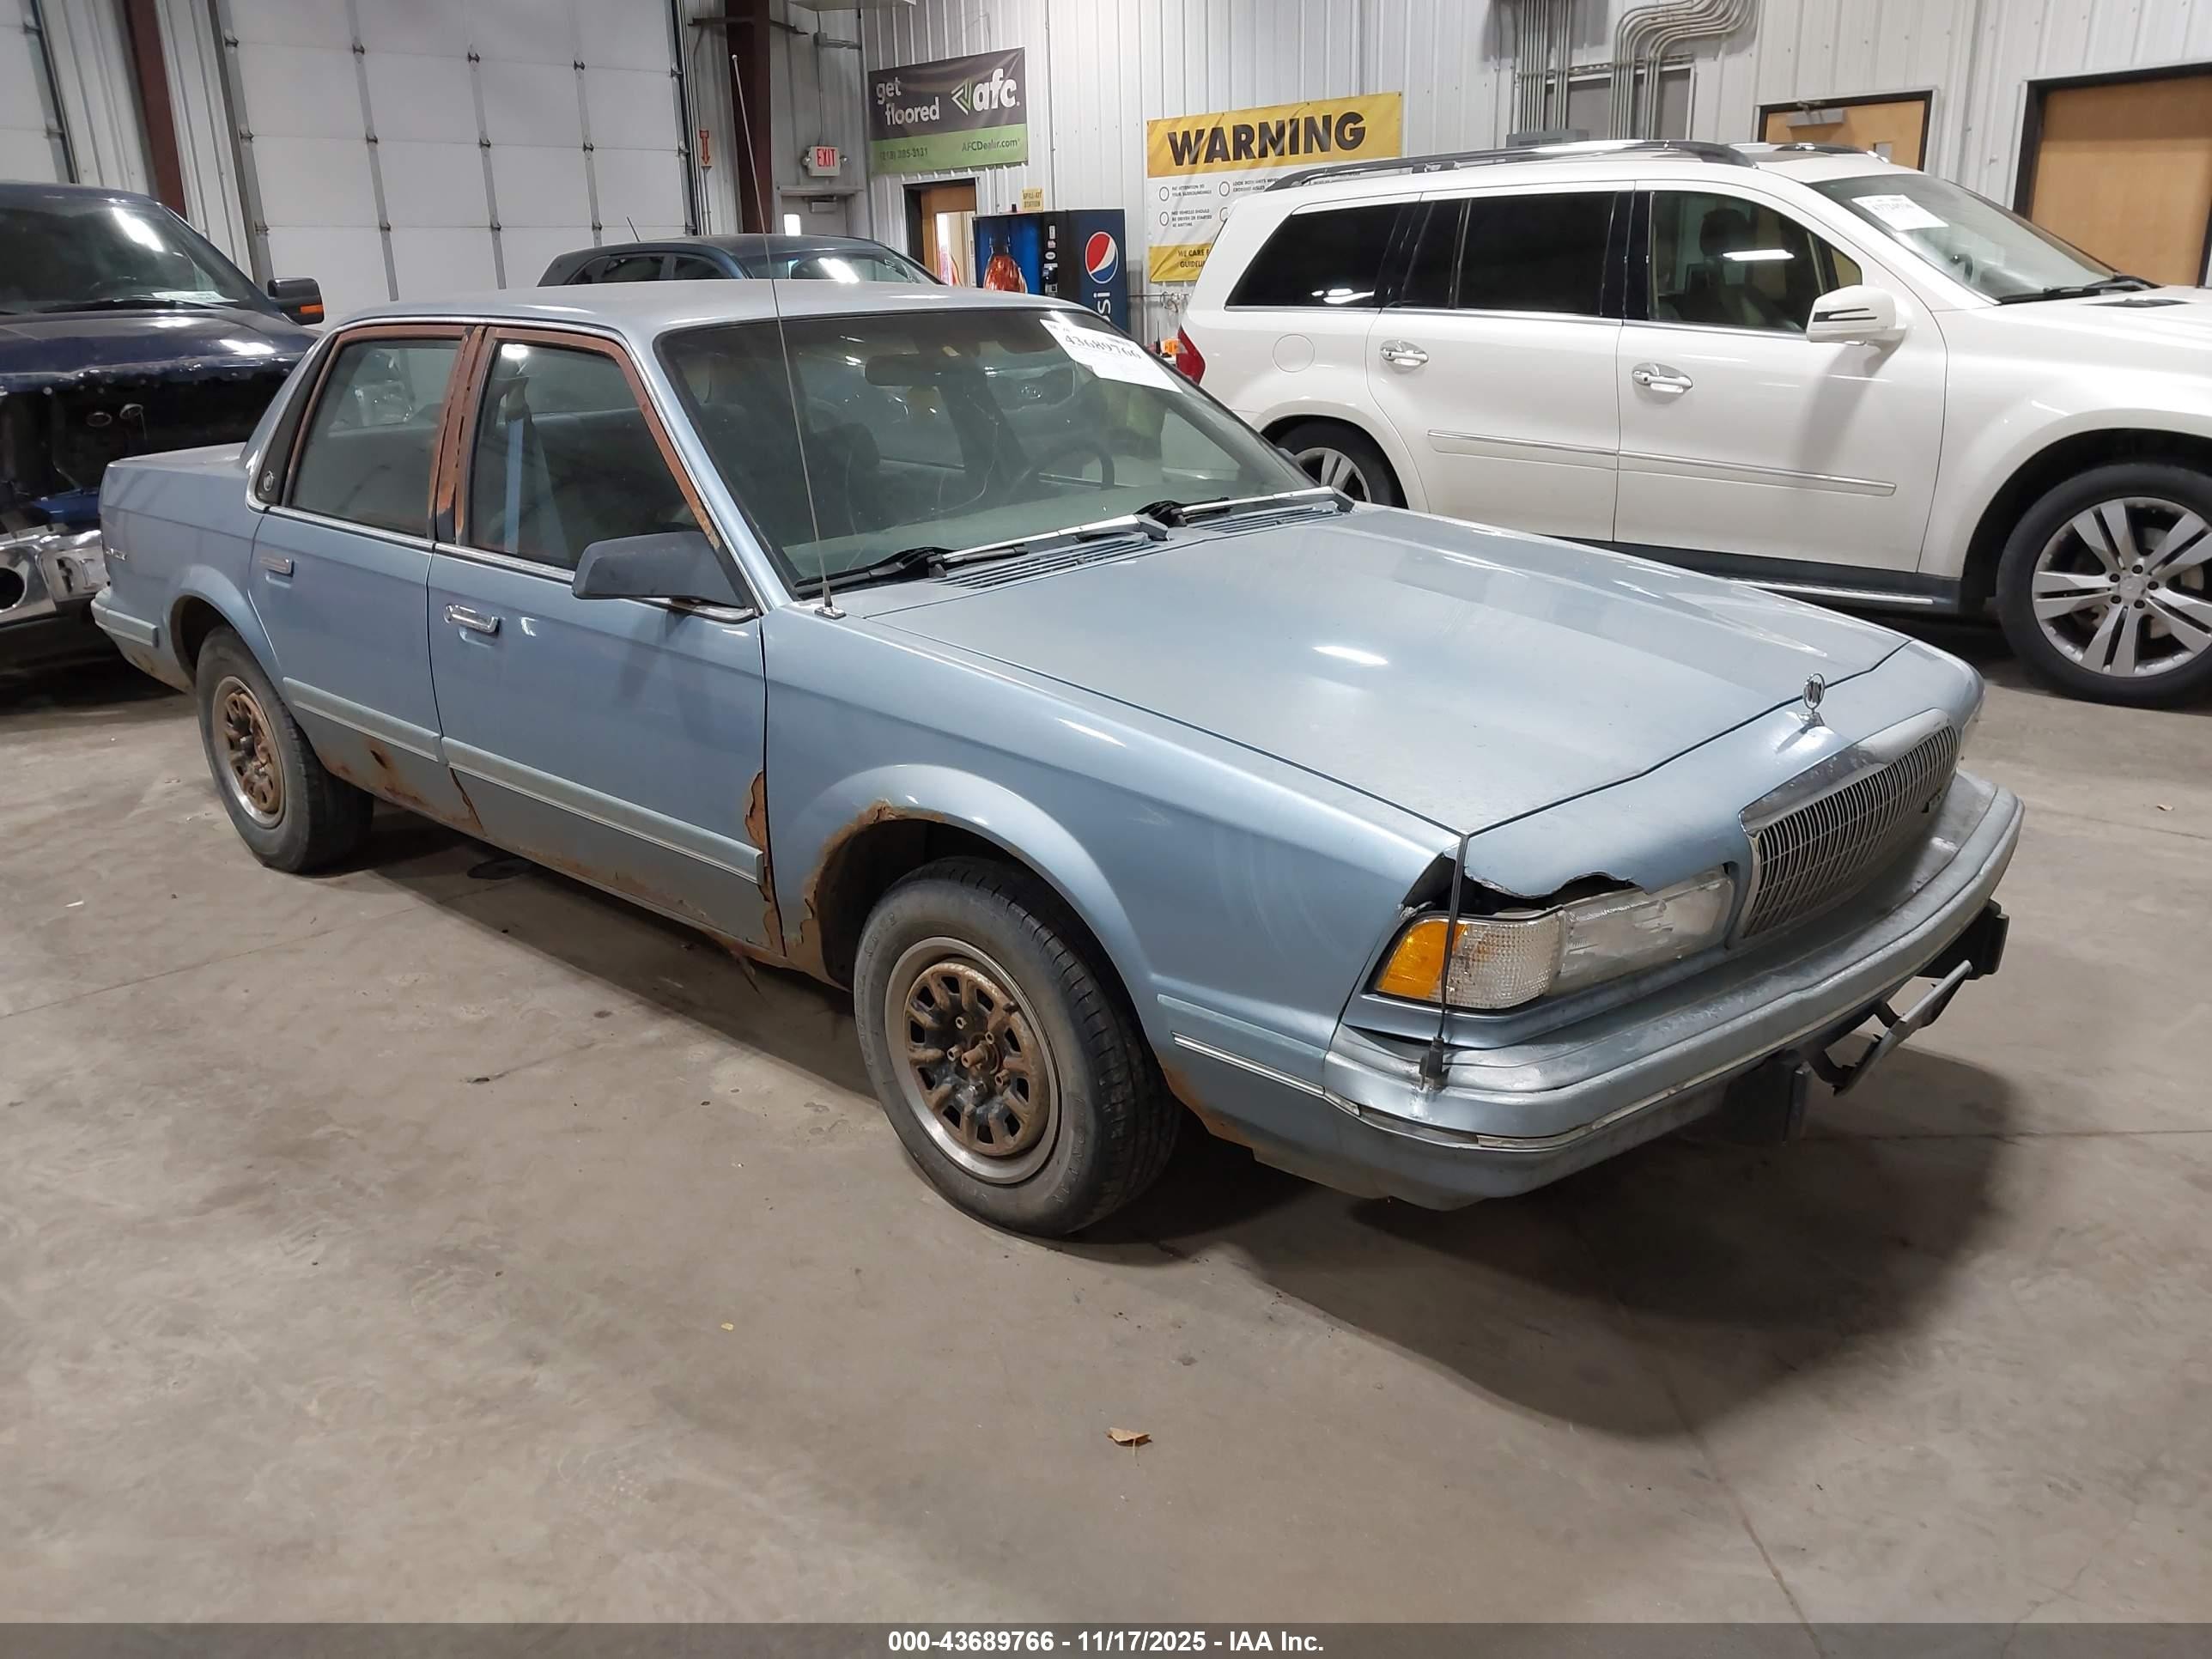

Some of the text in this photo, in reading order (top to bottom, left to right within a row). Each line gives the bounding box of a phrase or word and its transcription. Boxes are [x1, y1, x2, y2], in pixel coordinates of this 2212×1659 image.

[876, 76, 902, 105] get
[884, 96, 940, 126] floored
[1167, 111, 1367, 167] WARNING
[817, 148, 836, 167] EXIT
[1188, 248, 1205, 257] CARE
